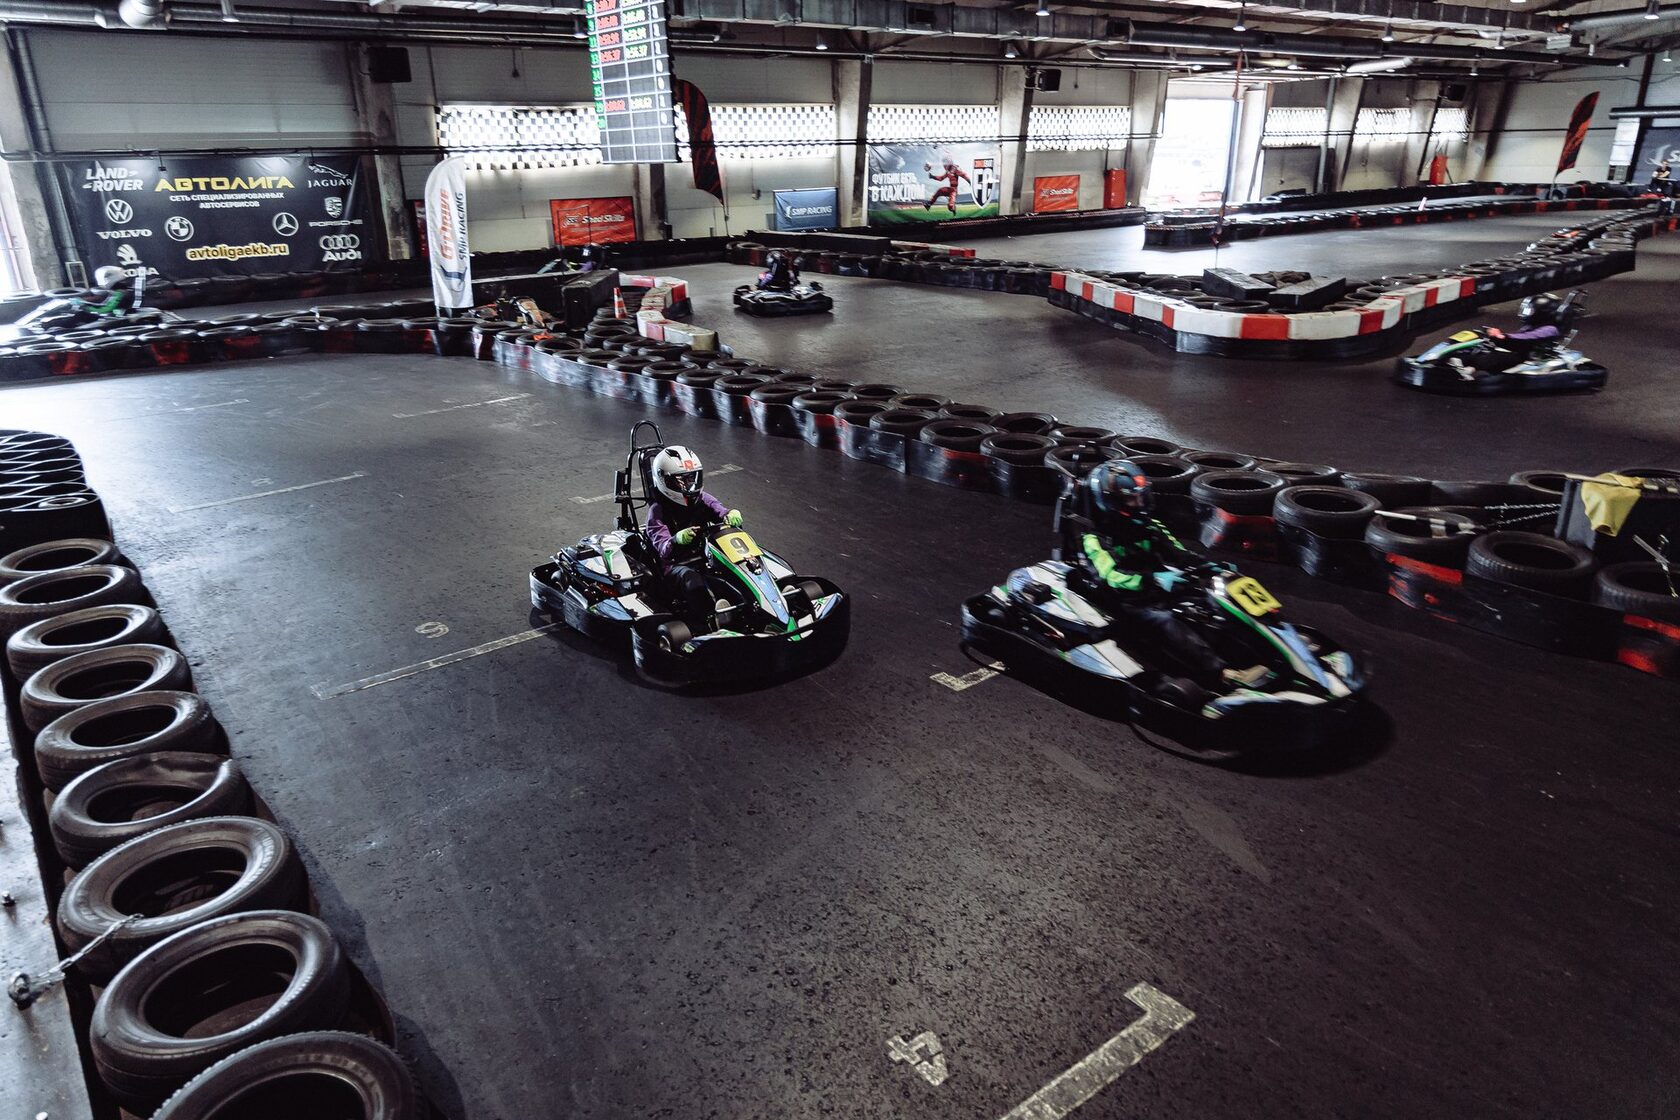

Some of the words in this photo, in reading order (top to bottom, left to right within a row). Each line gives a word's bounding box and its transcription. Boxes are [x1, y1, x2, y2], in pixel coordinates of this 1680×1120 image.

[86, 167, 129, 180] LAND
[92, 179, 144, 192] ROVER
[155, 176, 295, 192] АВТОЛИГА
[307, 178, 352, 188] JAGUAR
[169, 194, 191, 203] СЕТЬ
[191, 192, 285, 202] СПЕЦИАЛИЗИРОВАННЫХ
[199, 201, 261, 209] АВТОСЕРВИСОВ
[96, 228, 153, 240] VOLVO
[189, 244, 287, 260] avtoligaekb.ru
[730, 537, 750, 555] 9
